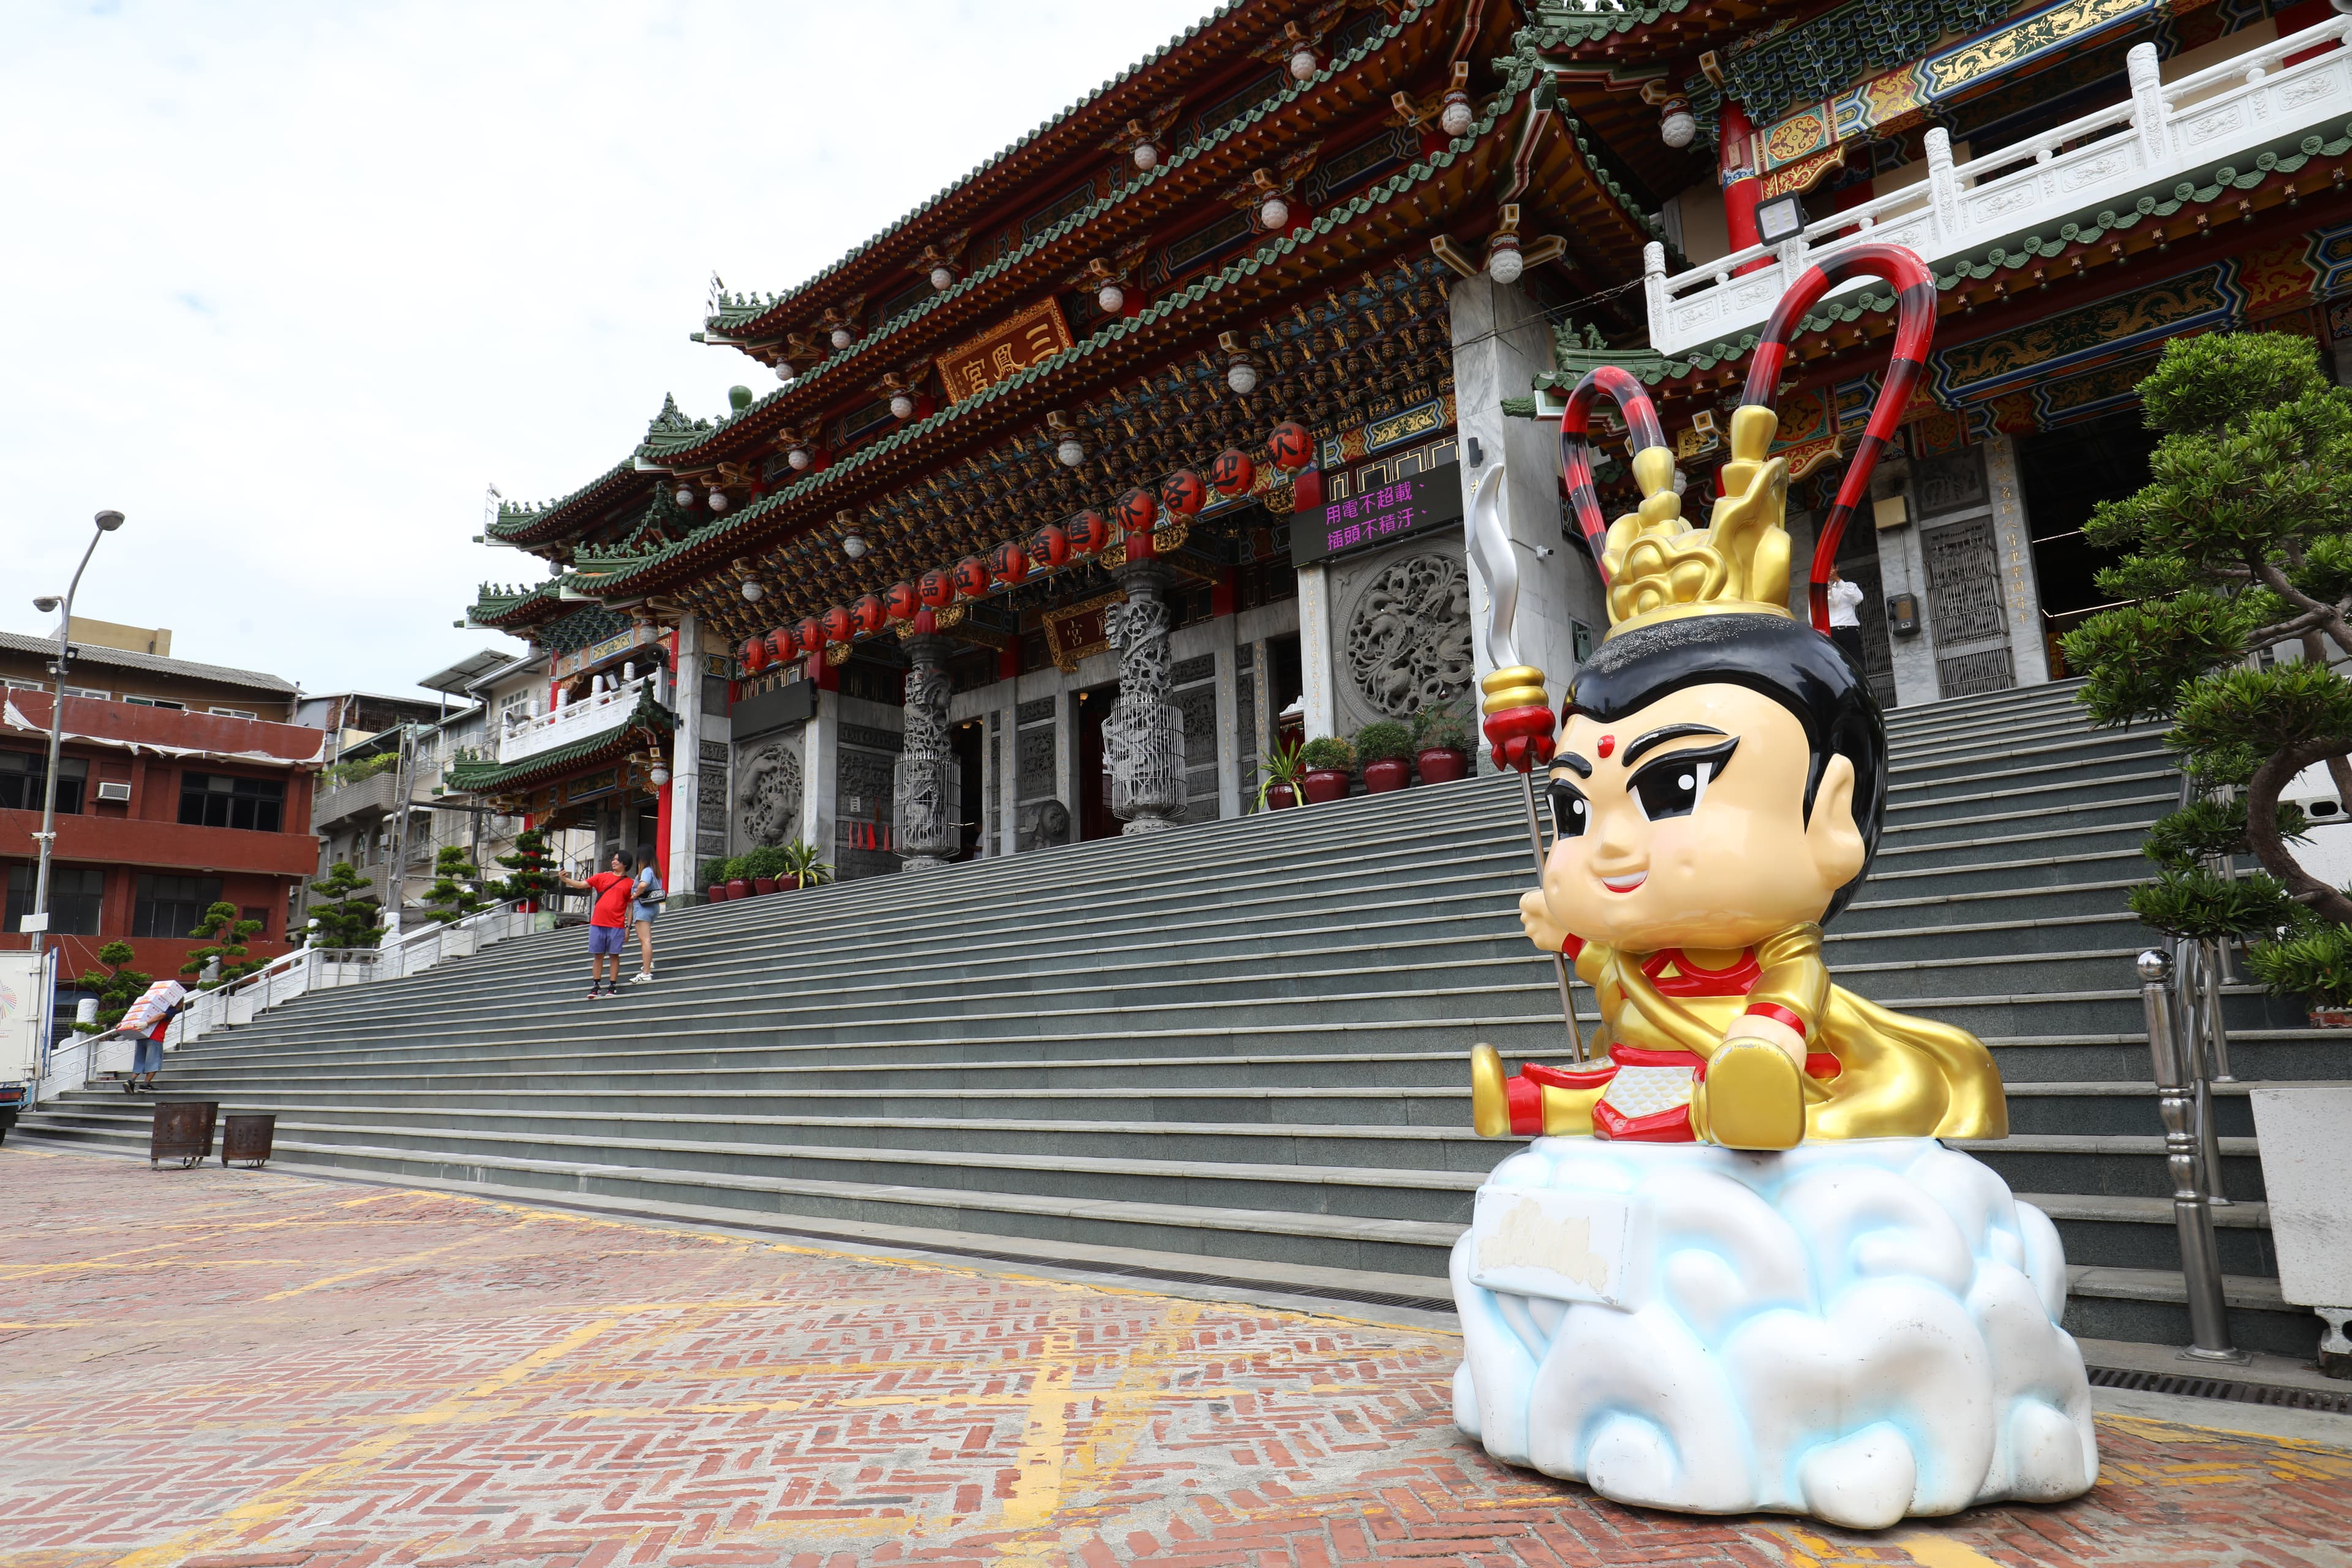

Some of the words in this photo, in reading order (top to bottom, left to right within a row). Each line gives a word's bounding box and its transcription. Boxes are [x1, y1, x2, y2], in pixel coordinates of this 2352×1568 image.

[1166, 476, 1192, 509] 各
[1117, 492, 1143, 529] 界
[1031, 529, 1051, 562] 香
